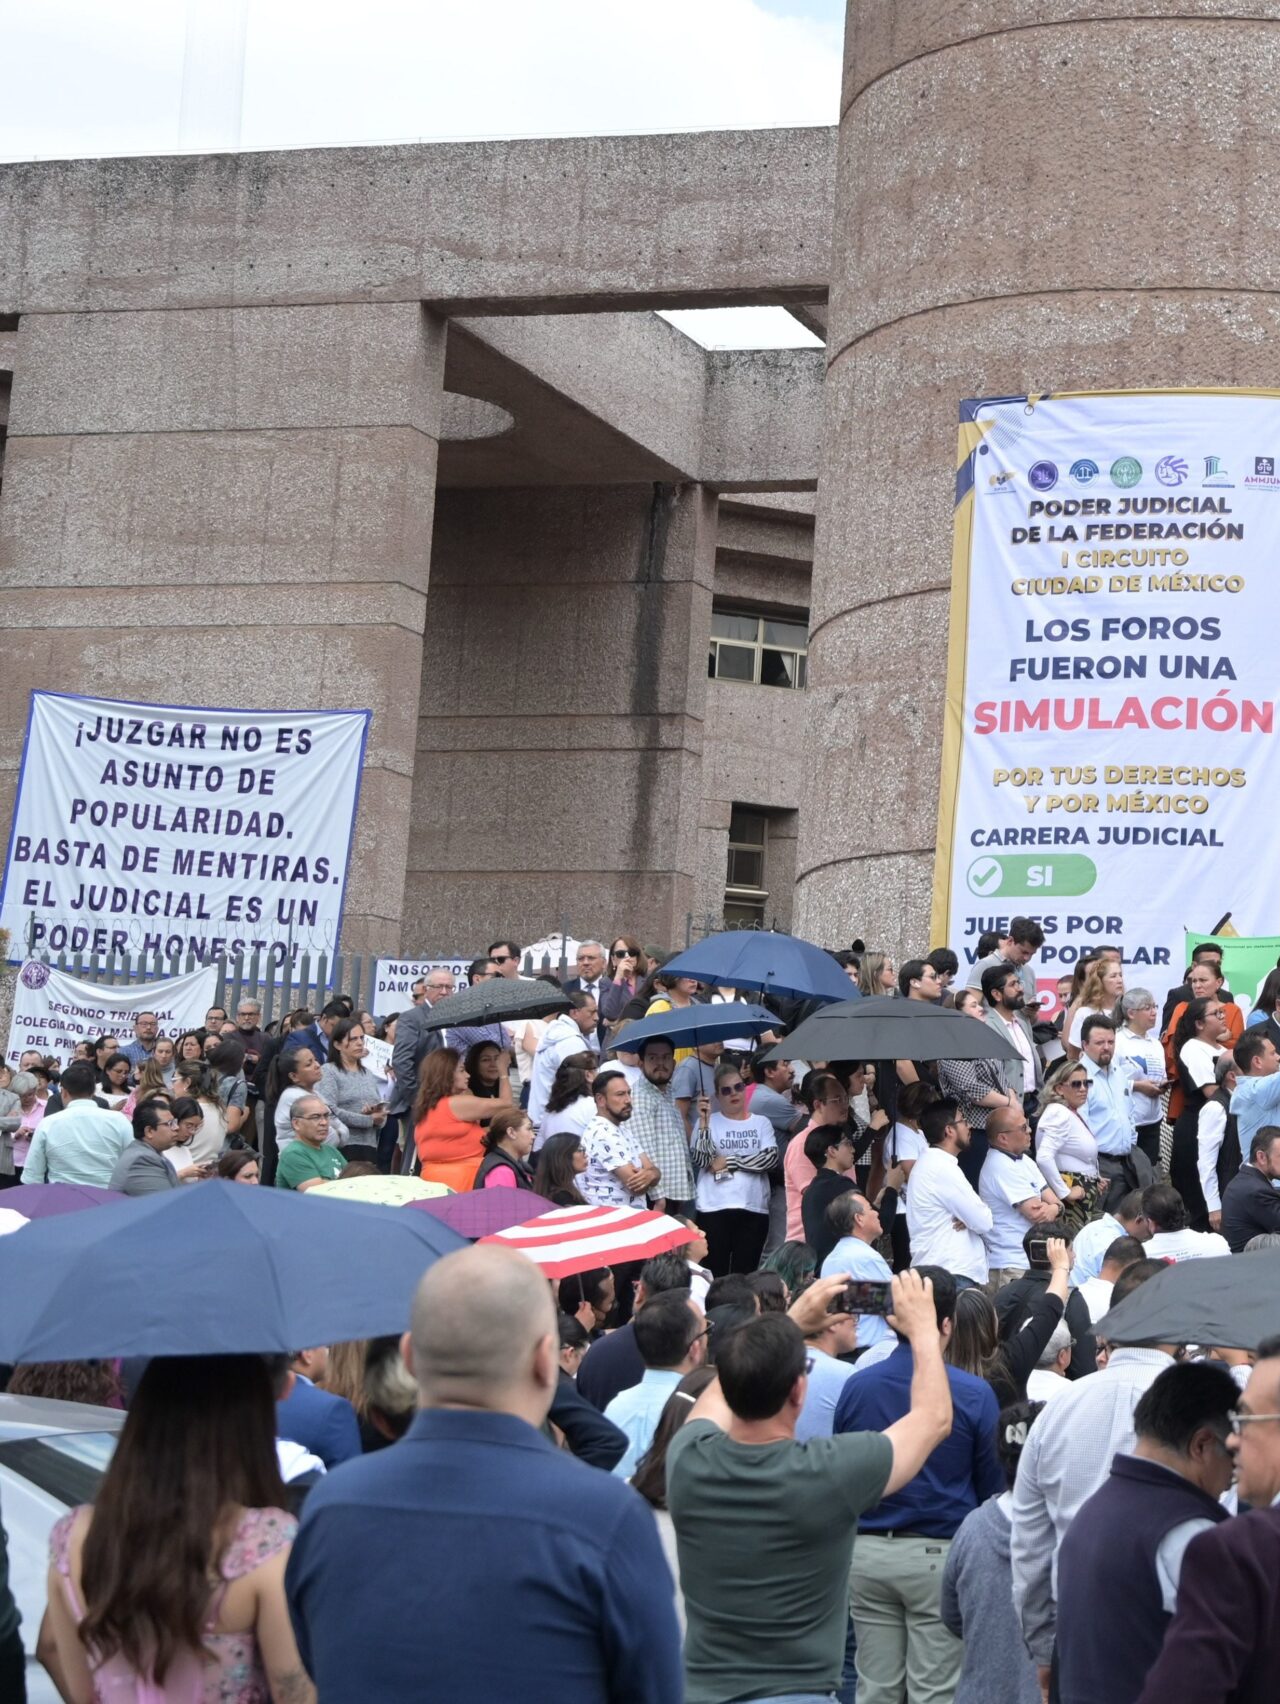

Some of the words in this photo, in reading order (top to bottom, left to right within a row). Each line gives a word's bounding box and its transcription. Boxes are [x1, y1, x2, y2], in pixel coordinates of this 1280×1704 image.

[1028, 497, 1112, 518] PODER
[1118, 496, 1233, 515] JUDICIAL
[1011, 526, 1041, 544] DE
[1048, 525, 1079, 542] LA
[1085, 518, 1244, 541] FEDERACIÓN
[1061, 551, 1069, 568] I
[1076, 548, 1189, 568] CIRCUITO
[1011, 575, 1103, 596] CIUDAD
[1109, 574, 1142, 593] DE
[1148, 570, 1245, 593] MÉXICO
[1025, 618, 1091, 643] LOS
[1101, 616, 1222, 642] FOROS
[1009, 655, 1148, 682] FUERON
[1160, 655, 1238, 681] UNA
[973, 689, 1274, 735] SIMULACIÓN
[75, 716, 207, 749] ¡JUZGAR
[221, 725, 263, 752] NO
[275, 728, 312, 755] ES
[100, 759, 223, 792] ASUNTO
[237, 768, 276, 796] DE
[992, 767, 1043, 787] POR
[1050, 765, 1097, 785] TUS
[1103, 765, 1246, 788] DERECHOS
[1024, 794, 1041, 813] Y
[1045, 793, 1099, 813] POR
[1106, 789, 1209, 814] MÉXICO
[70, 798, 293, 839] POPULARIDAD.
[970, 826, 1090, 847] CARRERA
[1097, 826, 1224, 847] JUDICIAL
[14, 835, 107, 869] BASTA
[121, 845, 160, 873] DE
[172, 849, 340, 884] MENTIRAS.
[1026, 864, 1053, 888] SI
[23, 879, 56, 907] EL
[70, 883, 211, 920] JUDICIAL
[225, 895, 263, 923] ES
[277, 898, 319, 927] UN
[964, 916, 1058, 935] JUES
[1066, 915, 1124, 935] POR
[31, 922, 128, 957] PODER
[143, 932, 299, 969] HONESTO!
[1040, 945, 1171, 966] POPLAR
[389, 964, 471, 976] NOSOOS
[48, 1000, 106, 1020] SEGUNDO
[109, 1010, 175, 1021] TRIBAL
[15, 1015, 84, 1034] COLEGIADO
[87, 1026, 107, 1036] EN
[110, 1028, 166, 1038] MATA
[26, 1035, 50, 1047] DEL
[720, 1139, 749, 1149] SOMOS
